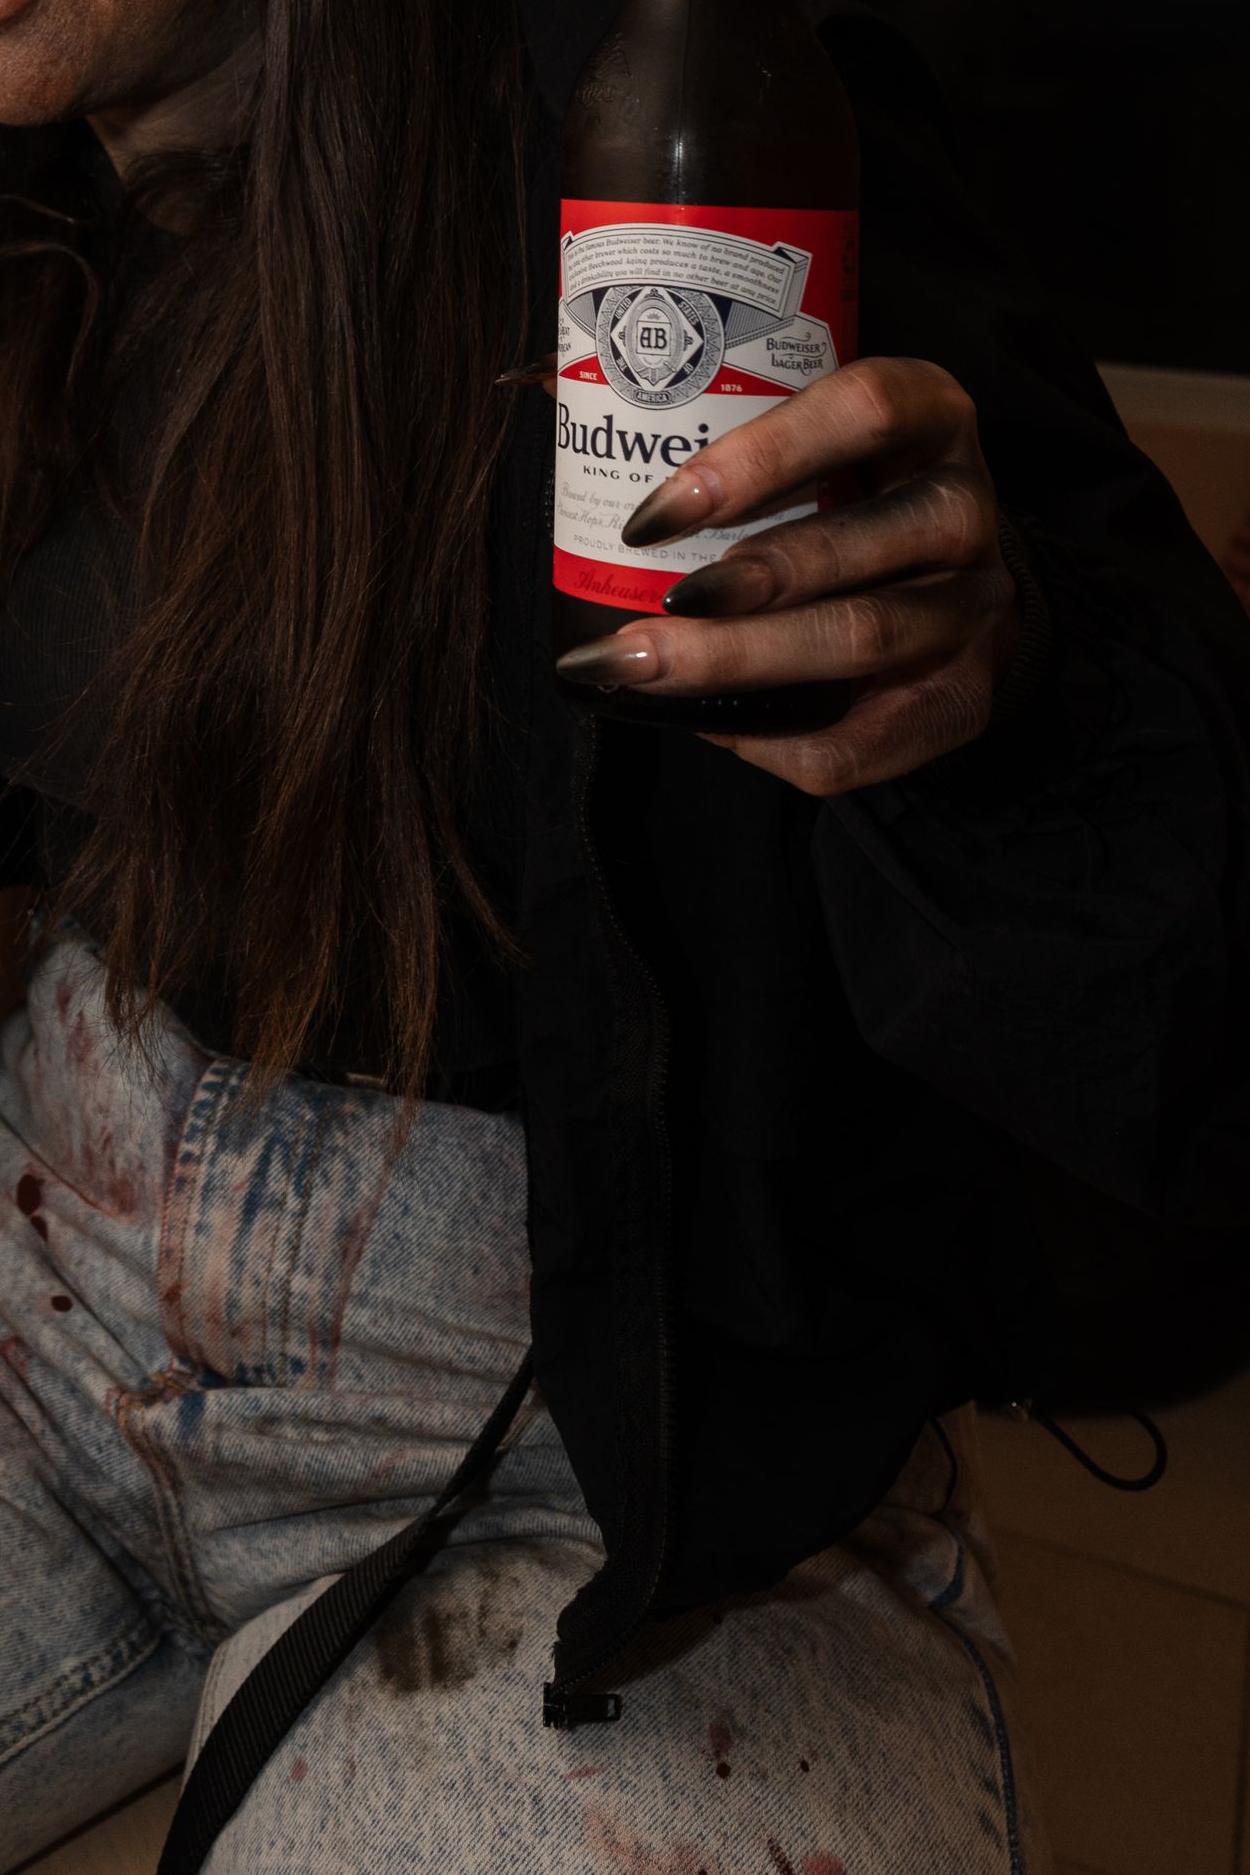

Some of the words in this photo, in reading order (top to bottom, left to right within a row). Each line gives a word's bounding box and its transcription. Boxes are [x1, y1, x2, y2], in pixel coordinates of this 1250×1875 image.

[606, 238, 640, 247] Budweiser
[677, 239, 697, 249] know
[700, 244, 710, 252] of
[723, 248, 749, 261] brand
[749, 256, 785, 275] produced
[617, 247, 637, 256] which
[639, 247, 660, 255] costs
[673, 250, 696, 260] much
[699, 253, 708, 261] to
[710, 256, 731, 266] brew
[732, 262, 749, 272] and
[644, 267, 660, 277] find
[685, 273, 709, 283] other
[710, 277, 729, 287] beer
[650, 258, 689, 269] produces
[732, 273, 780, 294] smoothness
[614, 297, 632, 319] UNITED
[678, 301, 700, 326] STATES
[639, 327, 668, 350] AB
[766, 337, 821, 354] BUDWEISER
[579, 371, 598, 381] SINCE
[637, 392, 669, 402] AMERICA
[721, 383, 743, 393] 1876
[583, 465, 620, 480] KING
[629, 472, 654, 483] OF
[574, 534, 614, 551] PROUDLY
[673, 550, 686, 561] IN
[692, 552, 718, 562] THE
